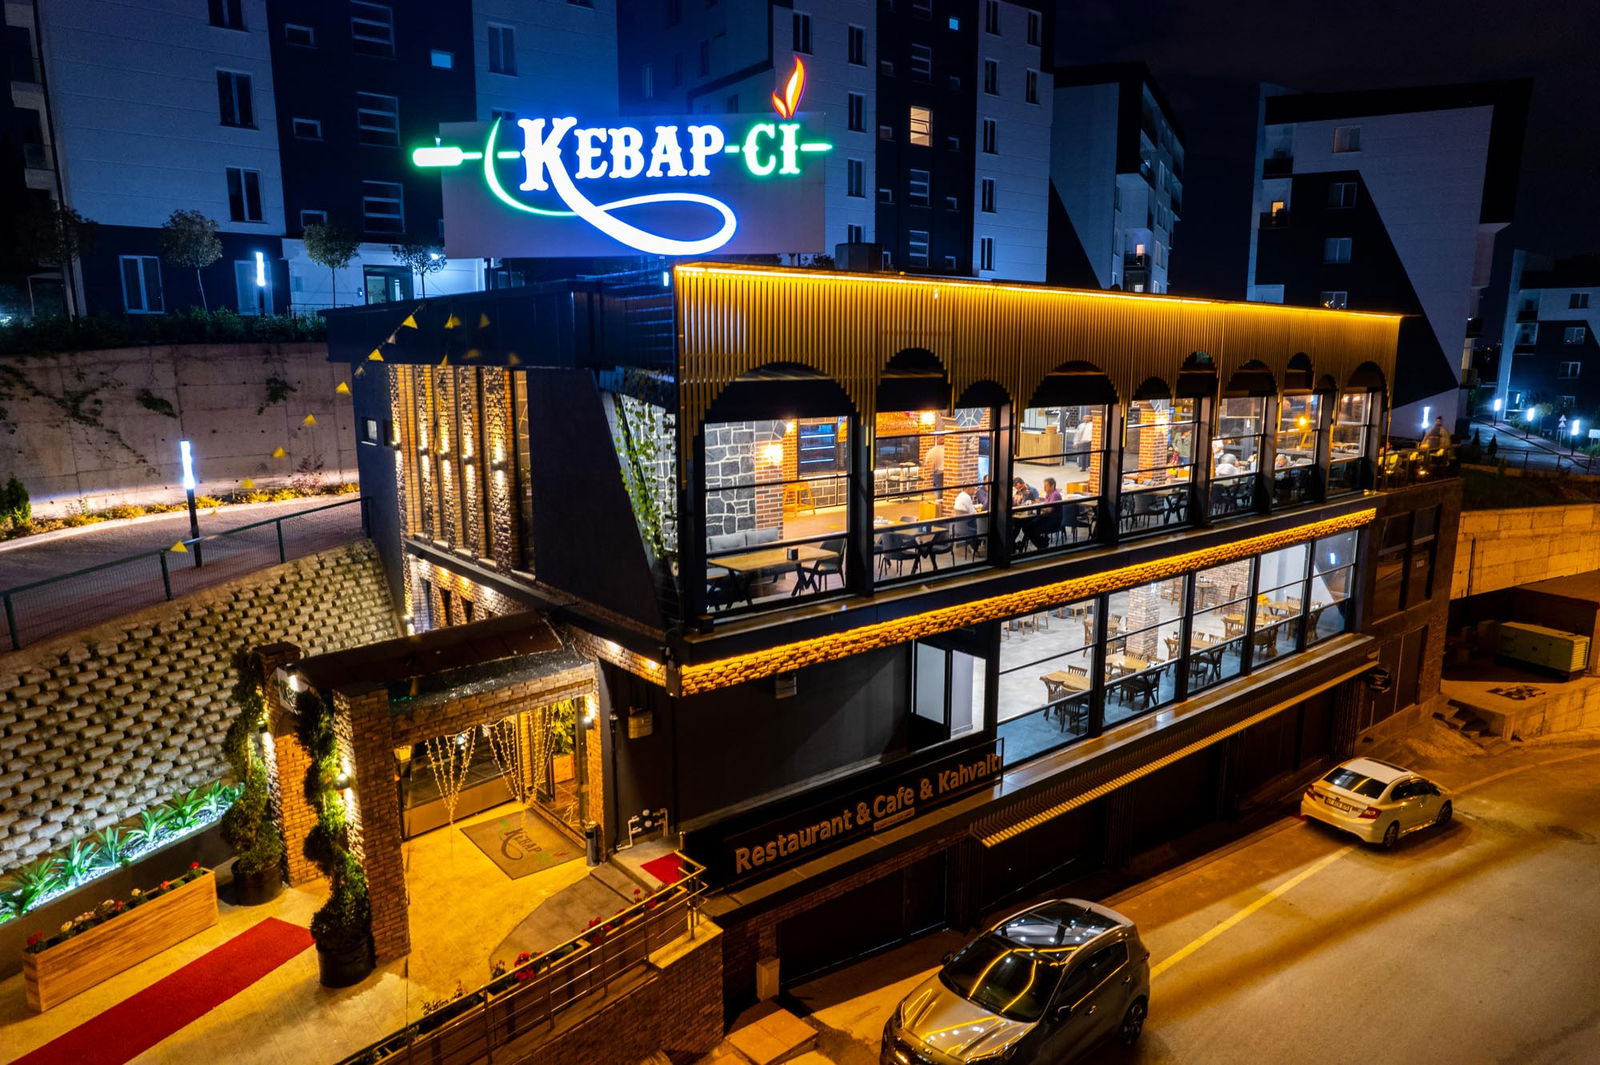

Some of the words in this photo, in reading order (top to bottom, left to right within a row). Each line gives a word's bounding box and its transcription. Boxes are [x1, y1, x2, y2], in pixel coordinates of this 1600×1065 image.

[735, 809, 853, 874] Restaurant
[856, 801, 872, 825] &
[873, 784, 915, 818] Cafe
[919, 778, 934, 800] &
